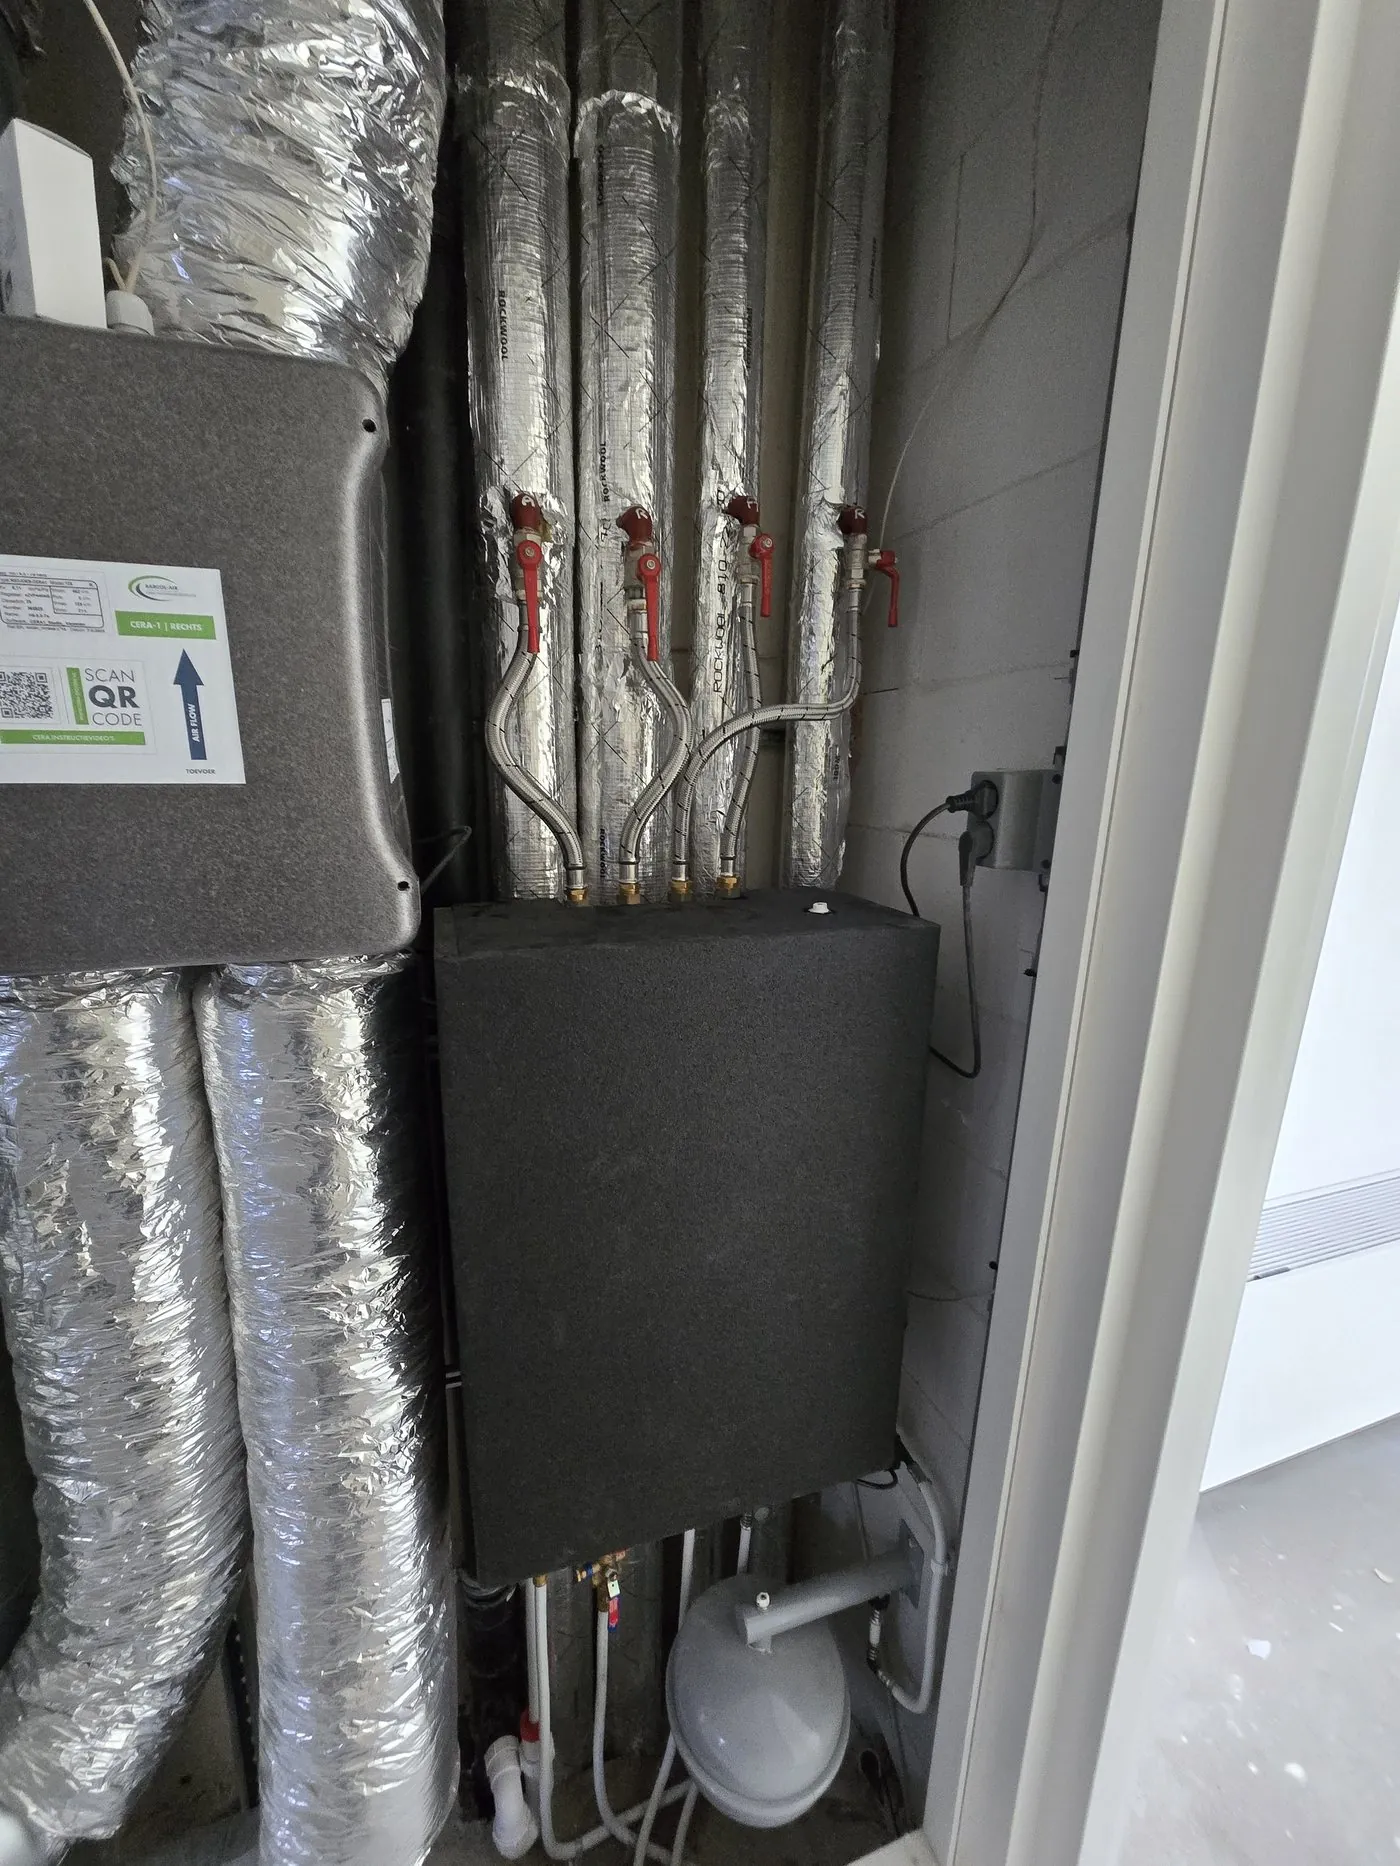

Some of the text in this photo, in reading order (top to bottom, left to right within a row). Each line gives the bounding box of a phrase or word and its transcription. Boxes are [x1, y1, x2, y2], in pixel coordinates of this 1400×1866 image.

[498, 289, 508, 361] ROCKWOOL
[600, 442, 610, 502] ROCKWOOL
[635, 507, 648, 520] R
[855, 508, 865, 519] R
[130, 621, 160, 629] CERA-1
[170, 622, 202, 631] RECHTS
[713, 613, 726, 693] ROCKWOOL
[84, 668, 135, 682] SCAN
[88, 685, 140, 708] QR
[92, 712, 142, 726] CODE
[187, 703, 200, 742] AIR FLOW
